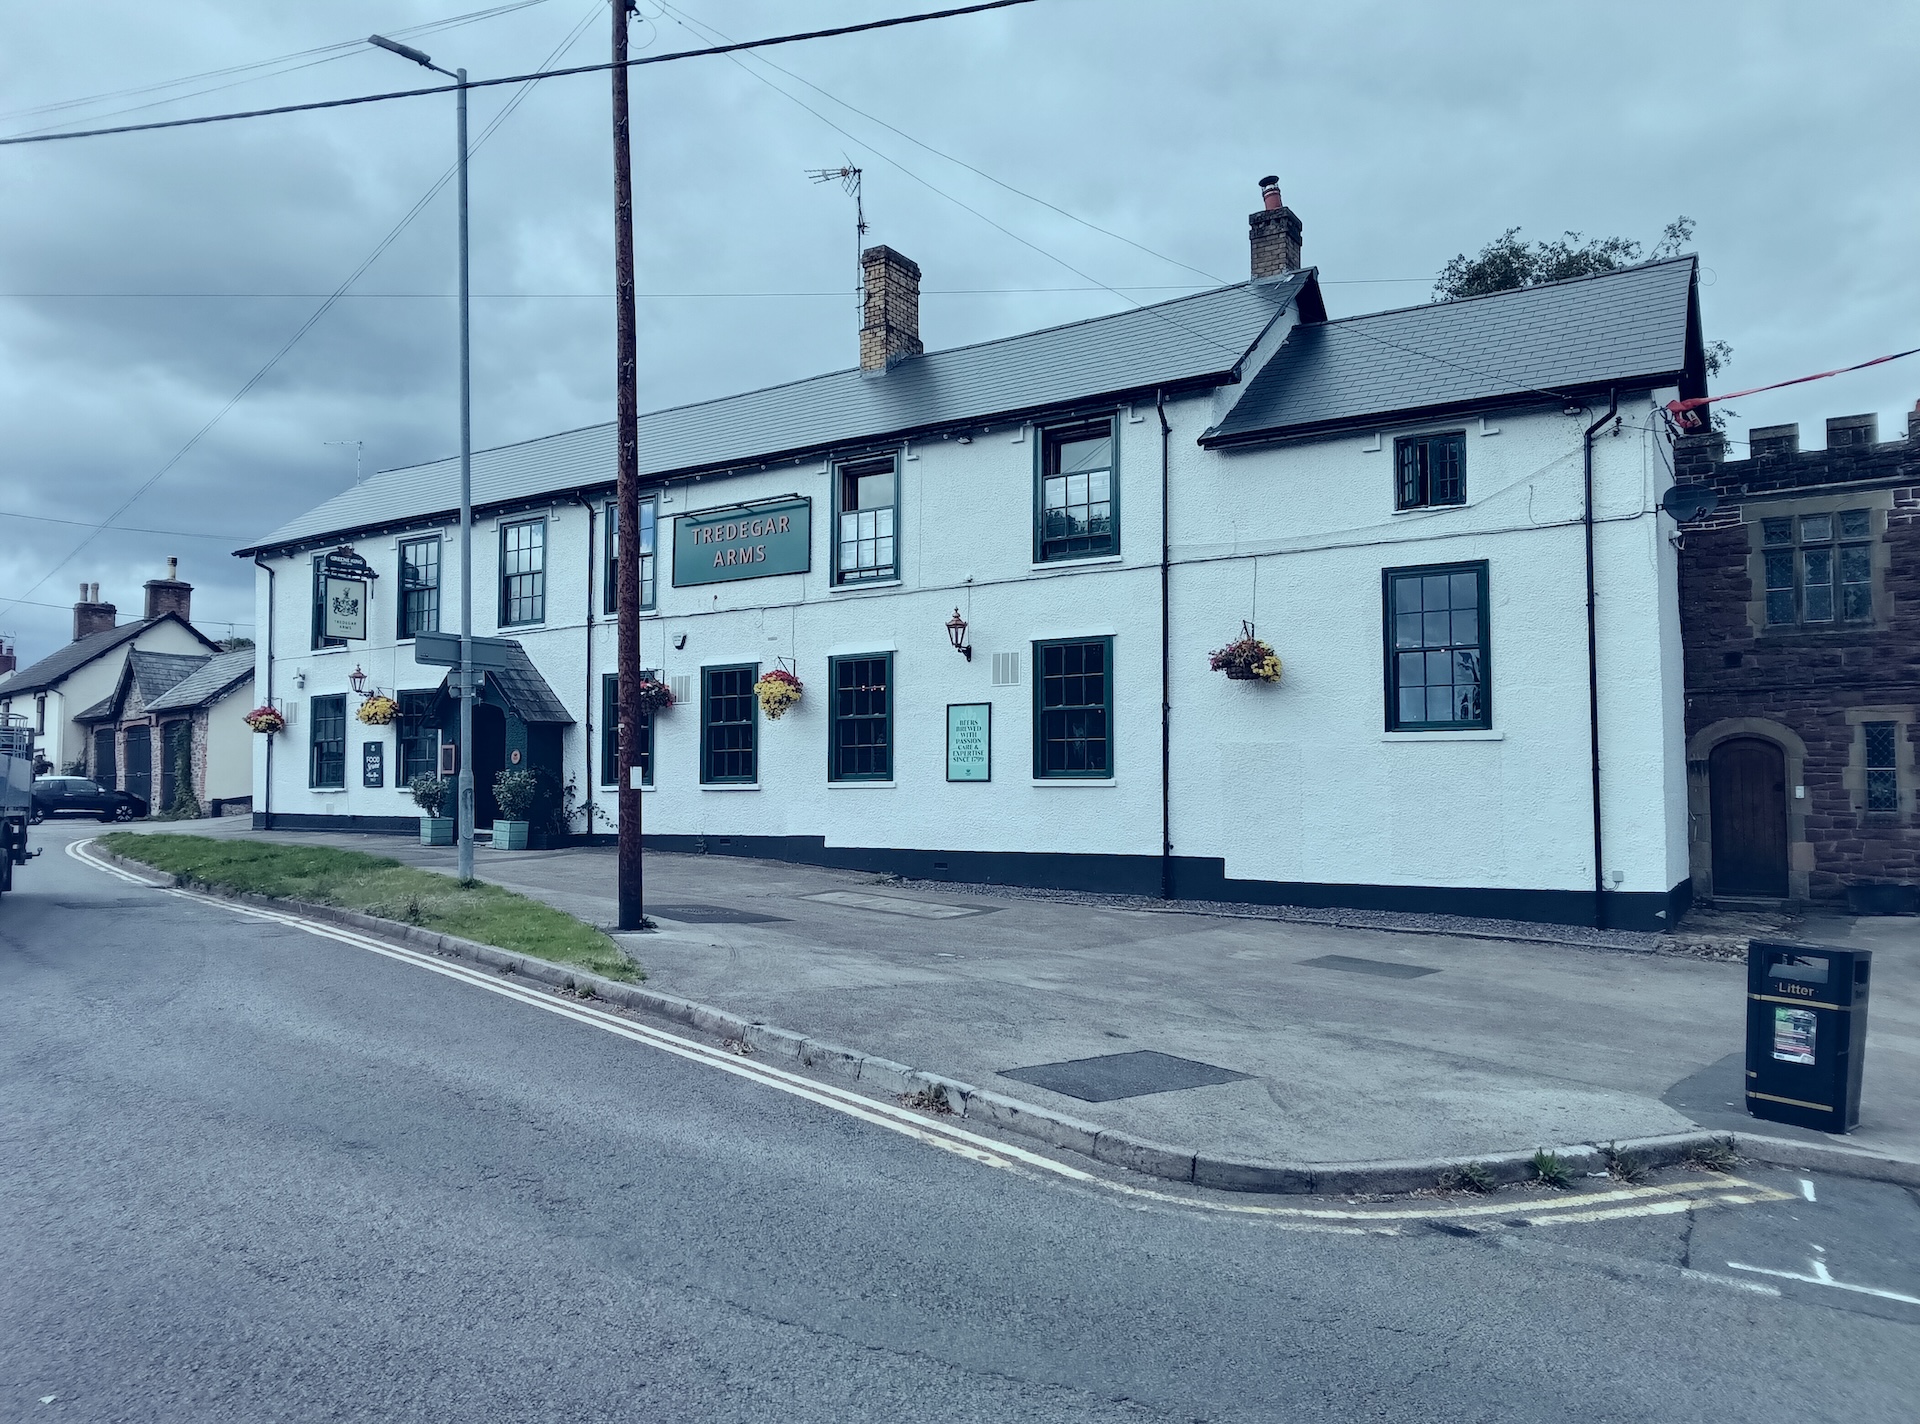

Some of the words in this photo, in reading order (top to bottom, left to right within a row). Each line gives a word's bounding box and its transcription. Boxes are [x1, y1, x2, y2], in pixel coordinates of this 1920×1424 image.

[691, 515, 790, 545] TREDEGAR
[713, 544, 766, 568] ARMS
[1778, 982, 1815, 997] Litter
